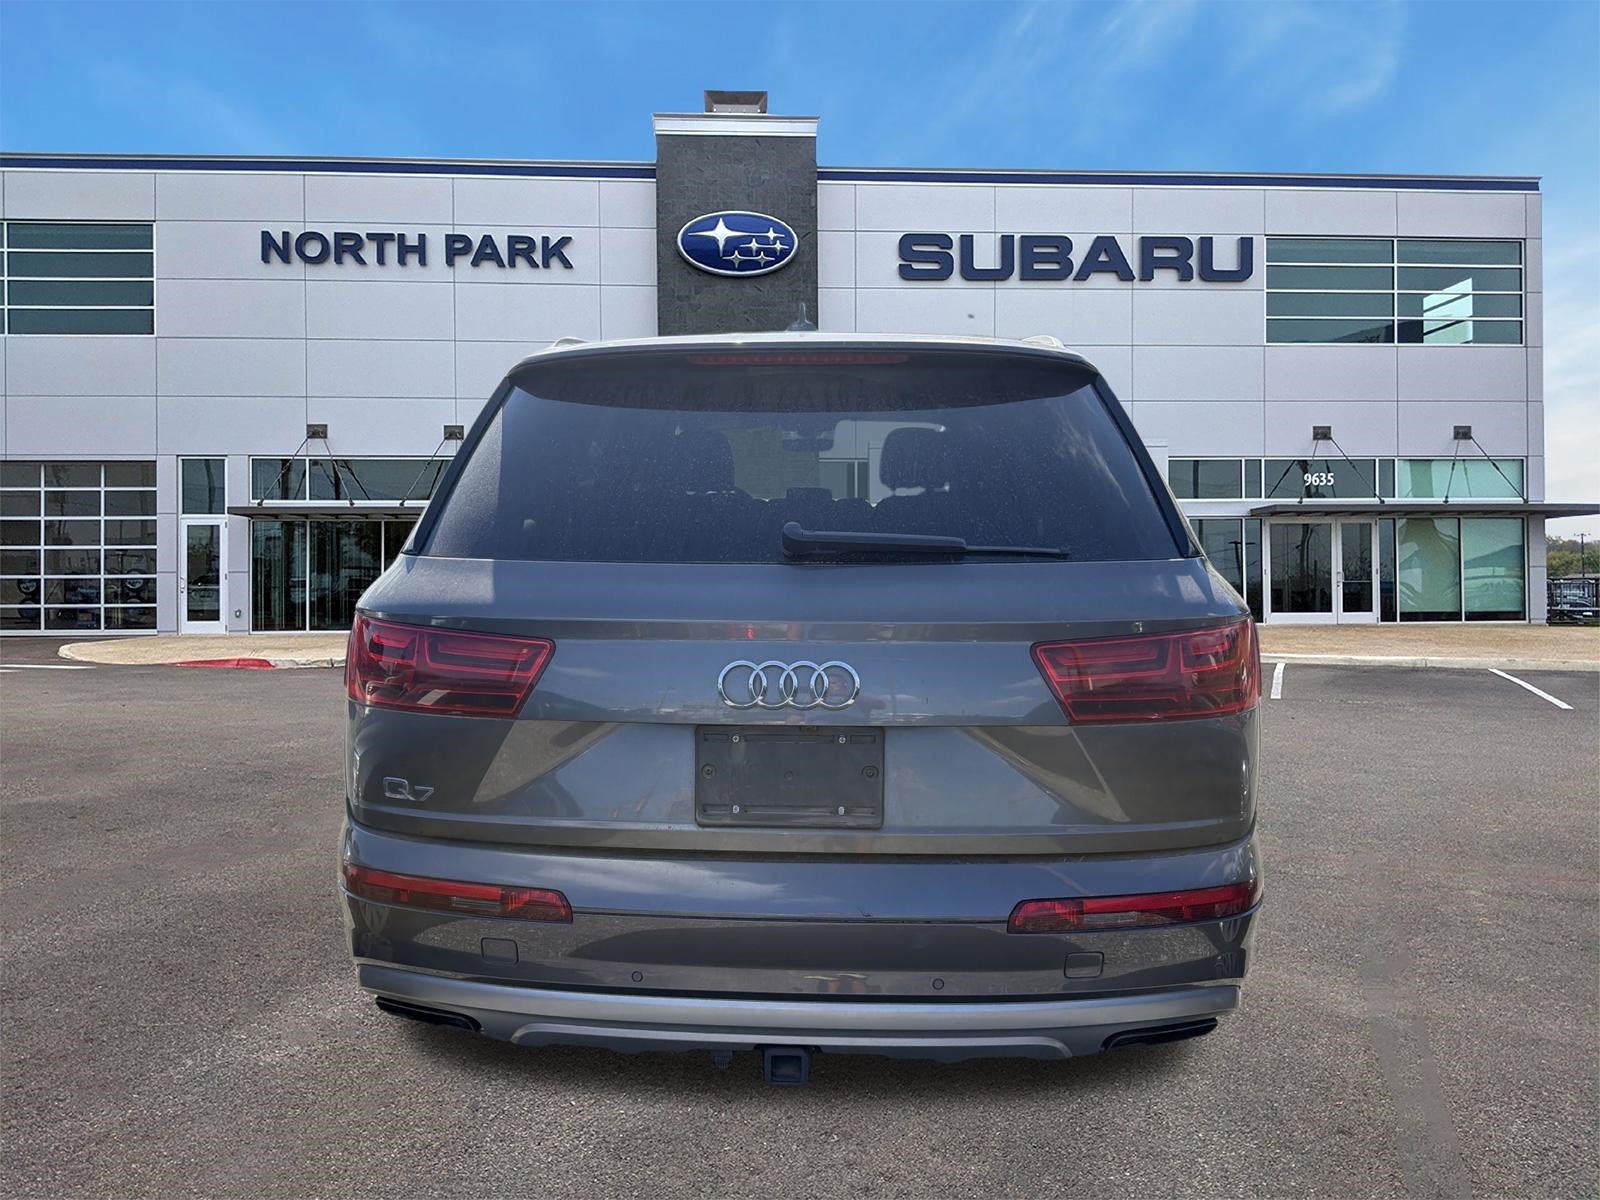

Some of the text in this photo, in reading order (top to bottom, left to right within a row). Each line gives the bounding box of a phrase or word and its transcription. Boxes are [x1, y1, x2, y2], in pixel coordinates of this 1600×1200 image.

[260, 231, 574, 269] NORTH PARK
[898, 233, 1254, 282] SUBARU
[1303, 472, 1335, 486] 9635
[383, 776, 434, 801] Q7
